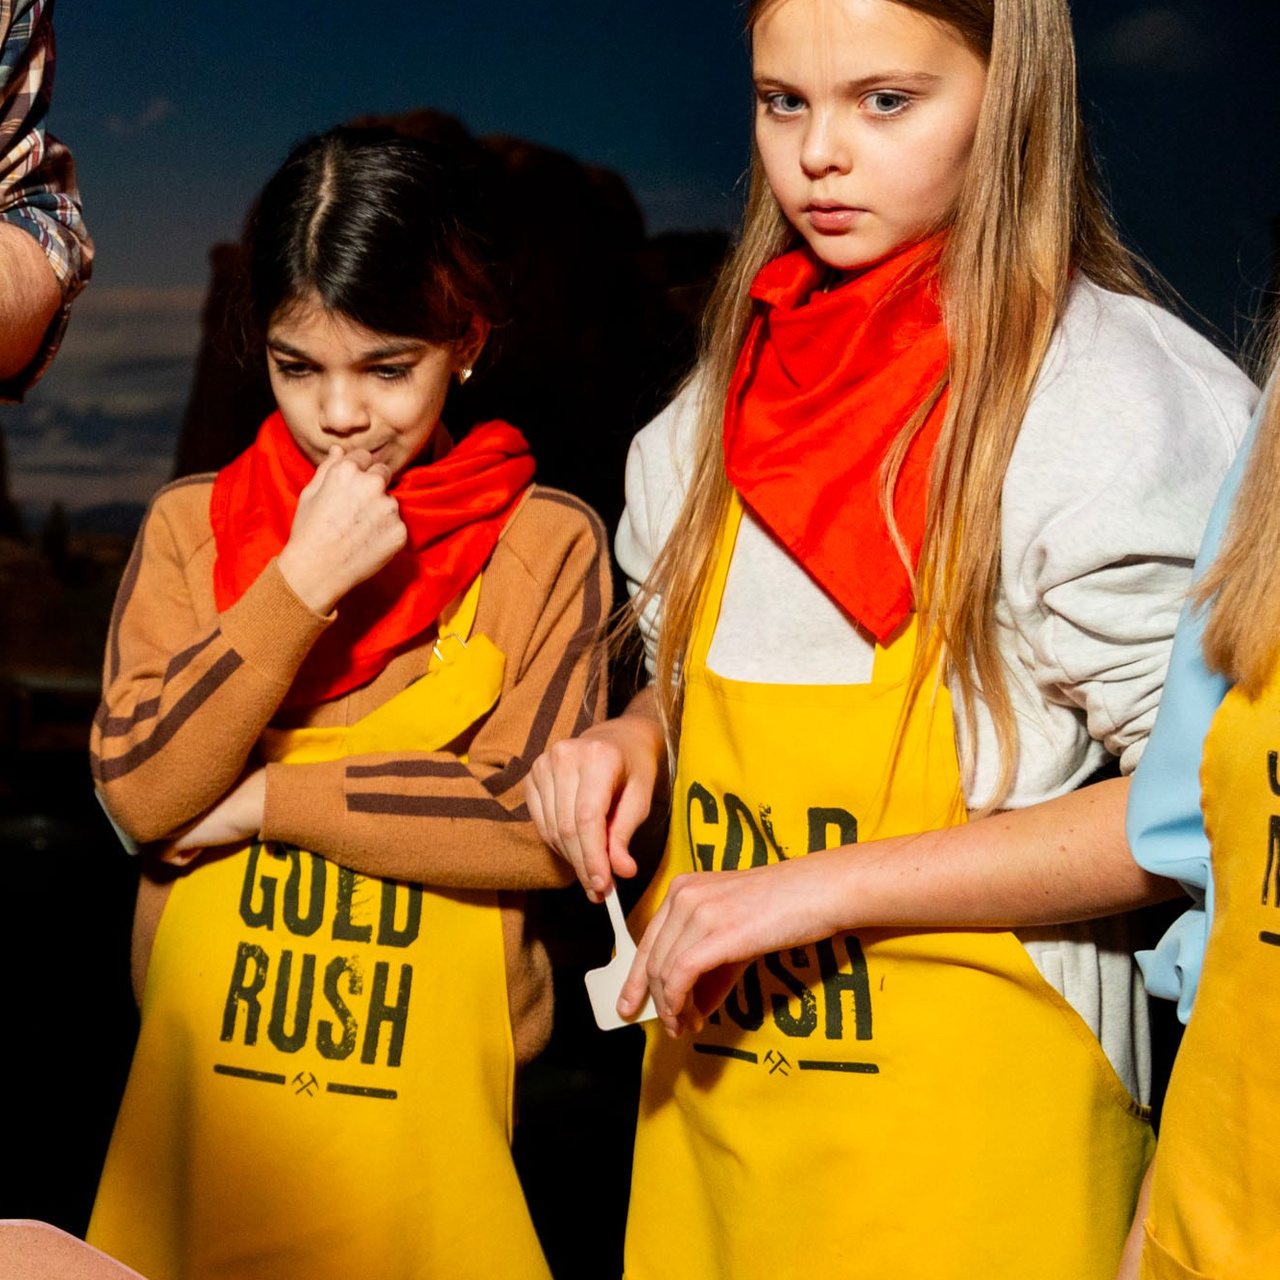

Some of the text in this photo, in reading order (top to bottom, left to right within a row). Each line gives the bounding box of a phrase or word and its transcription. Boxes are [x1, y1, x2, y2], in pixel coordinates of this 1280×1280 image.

[238, 839, 424, 949] GOLD
[219, 941, 413, 1068] RUSH
[708, 934, 873, 1041] USH
